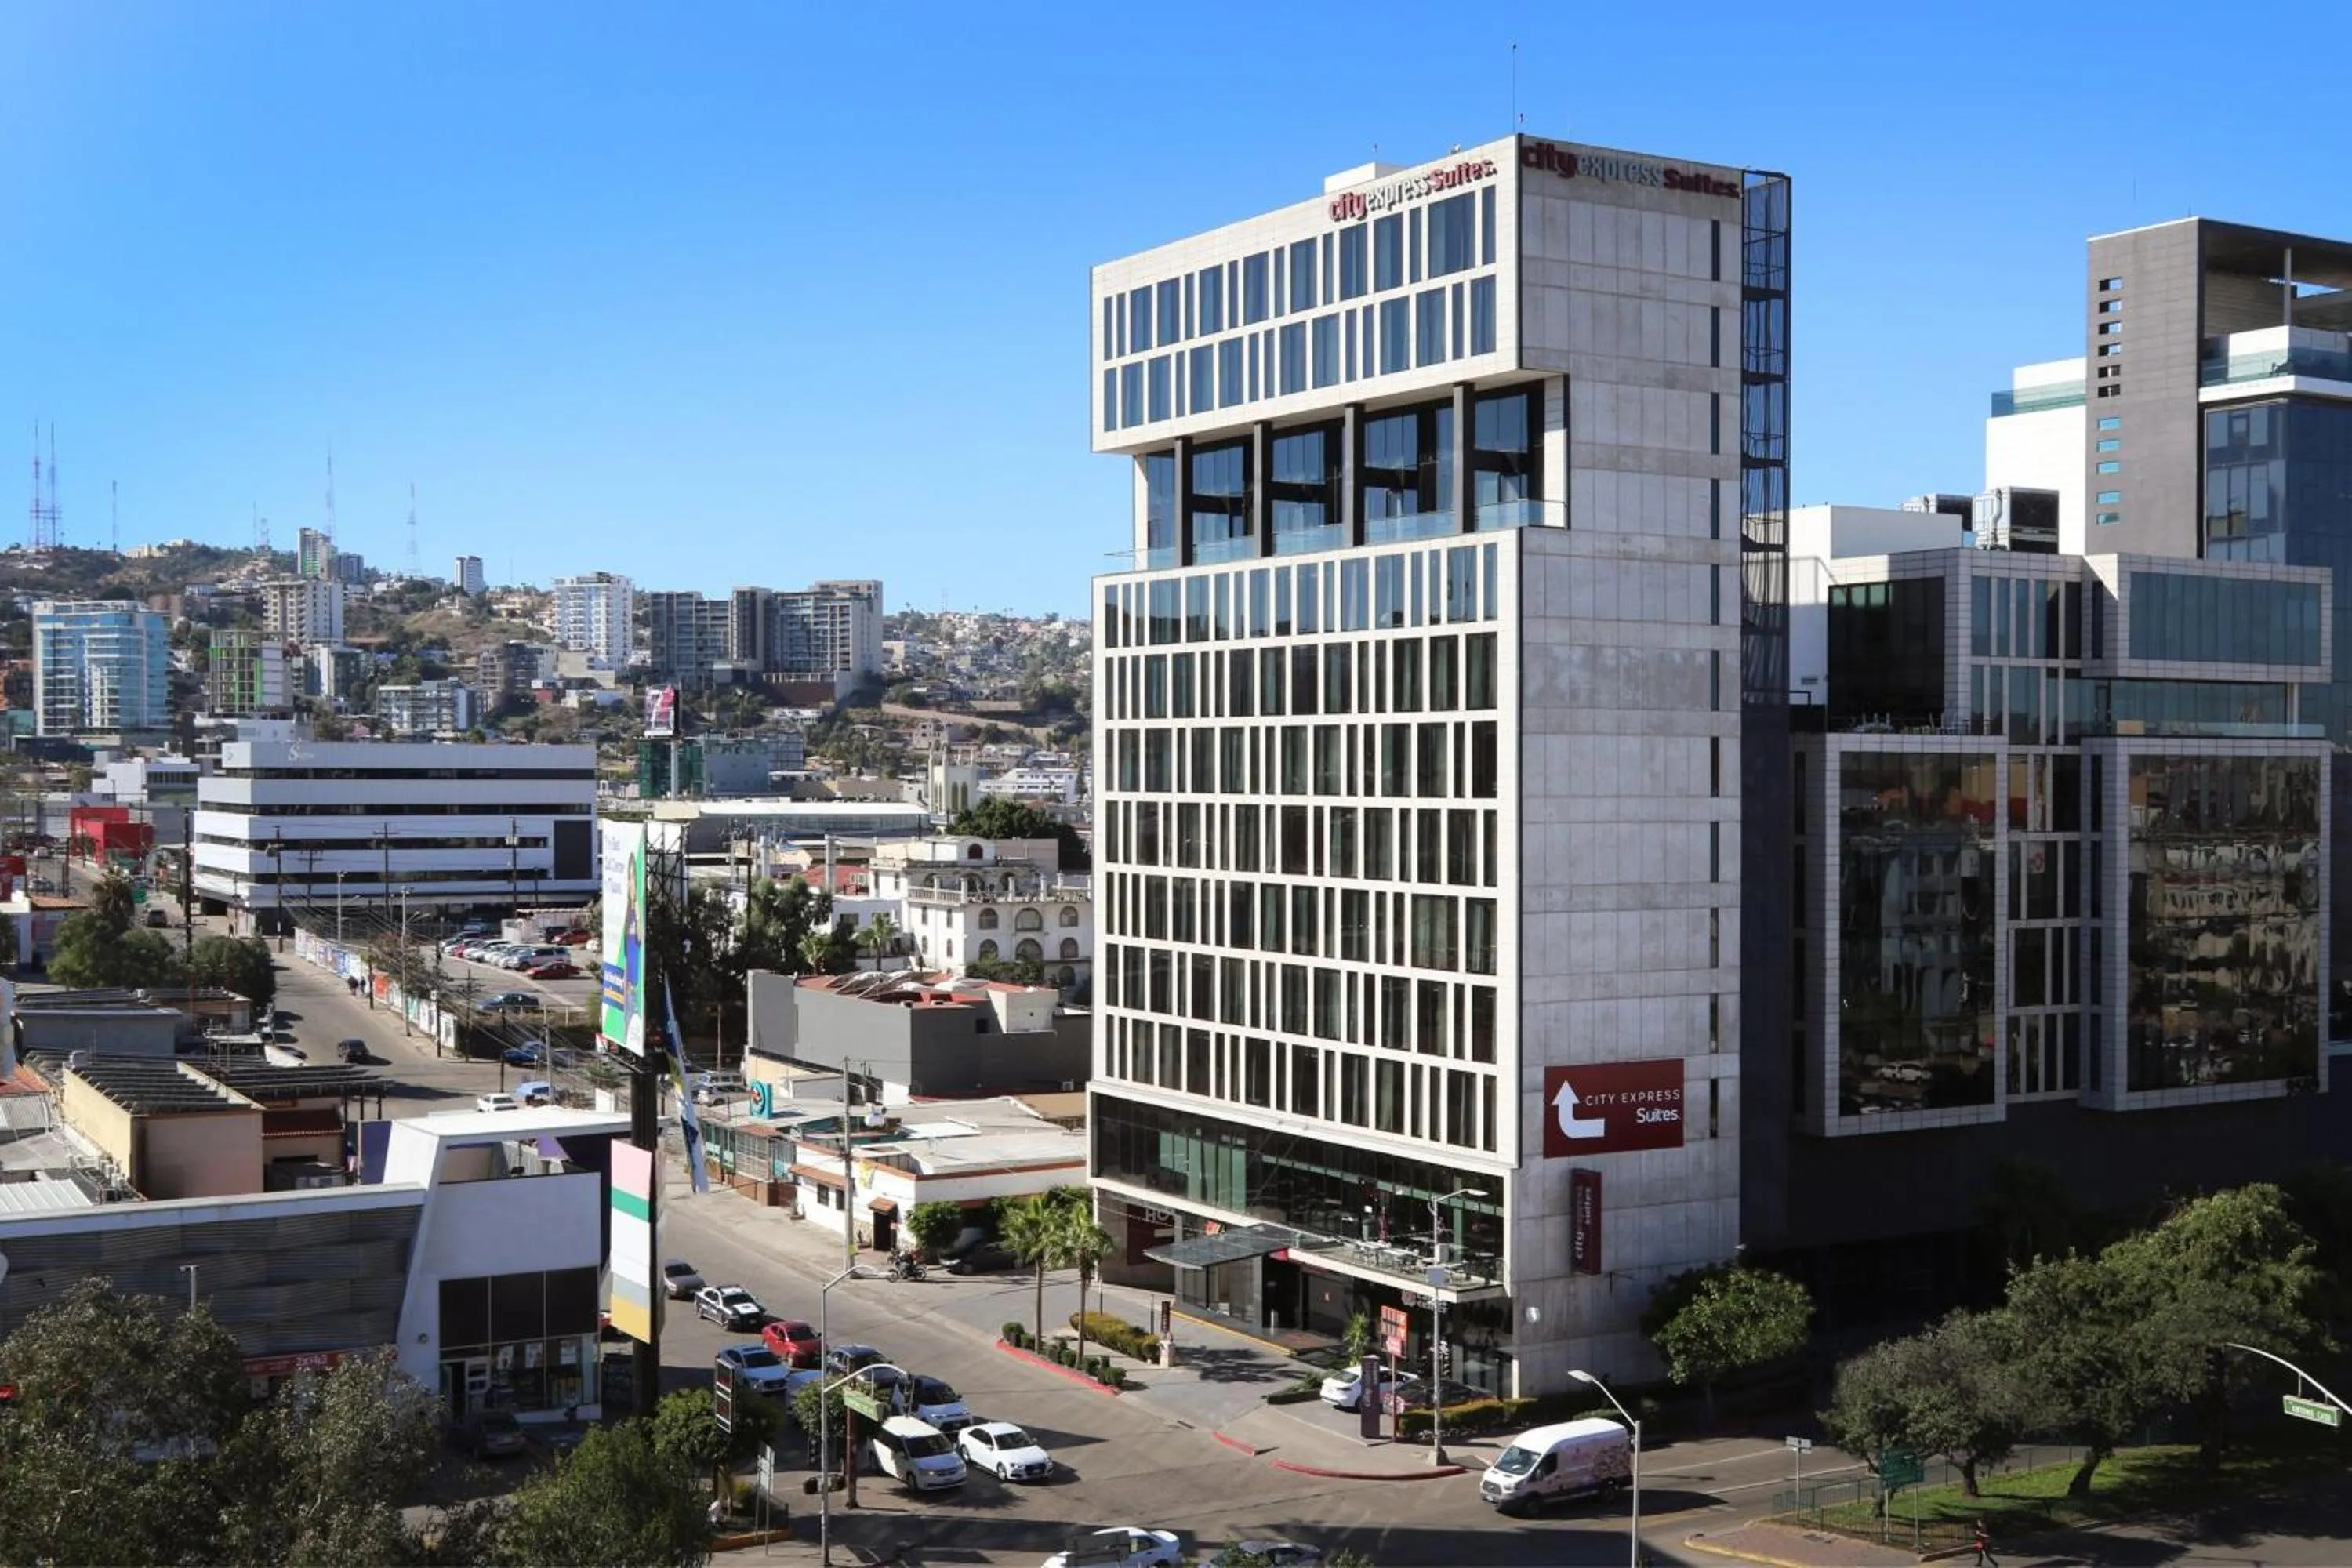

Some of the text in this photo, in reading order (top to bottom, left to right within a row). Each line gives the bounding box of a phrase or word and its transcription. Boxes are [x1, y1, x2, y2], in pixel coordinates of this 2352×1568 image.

[1585, 1088, 1680, 1107] CITY EXPRESS
[1635, 1106, 1679, 1124] Suites
